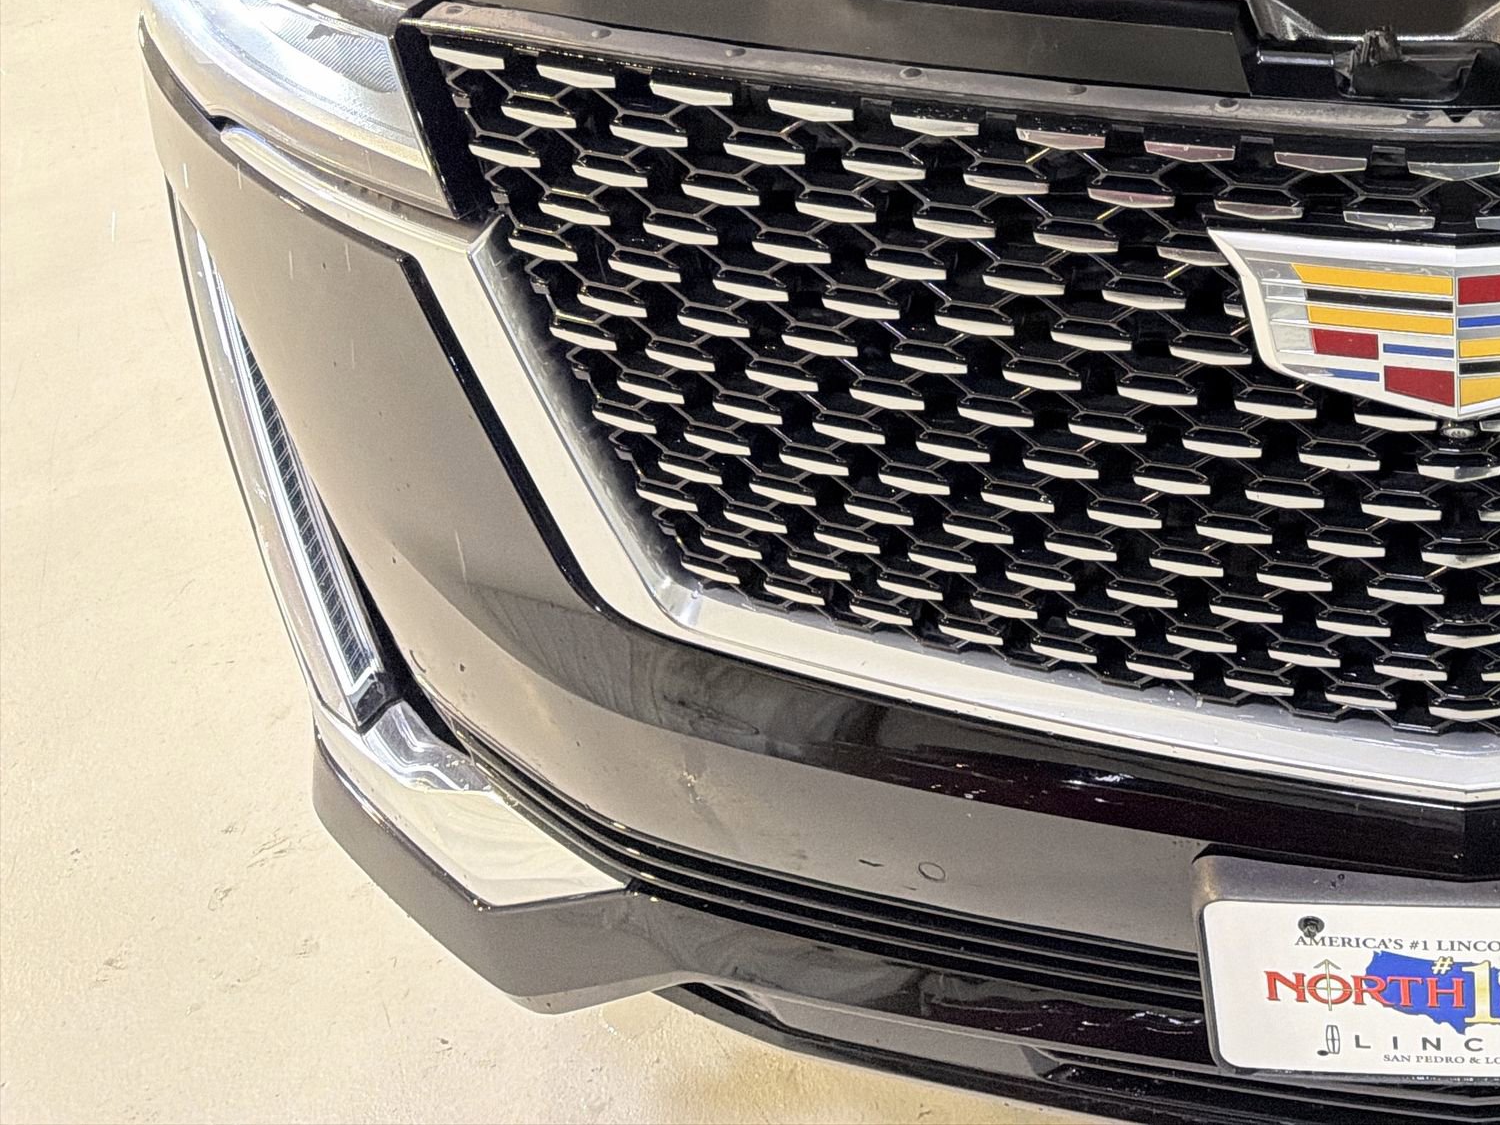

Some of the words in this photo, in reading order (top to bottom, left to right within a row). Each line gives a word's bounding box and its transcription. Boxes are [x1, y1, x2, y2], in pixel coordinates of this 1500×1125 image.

[1294, 935, 1404, 950] AMERICA'S
[1409, 939, 1430, 951] #1
[1264, 970, 1467, 1009] NORTH
[1383, 1054, 1412, 1063] SAN
[1415, 1055, 1465, 1065] PEDRO
[1469, 1056, 1482, 1065] &
